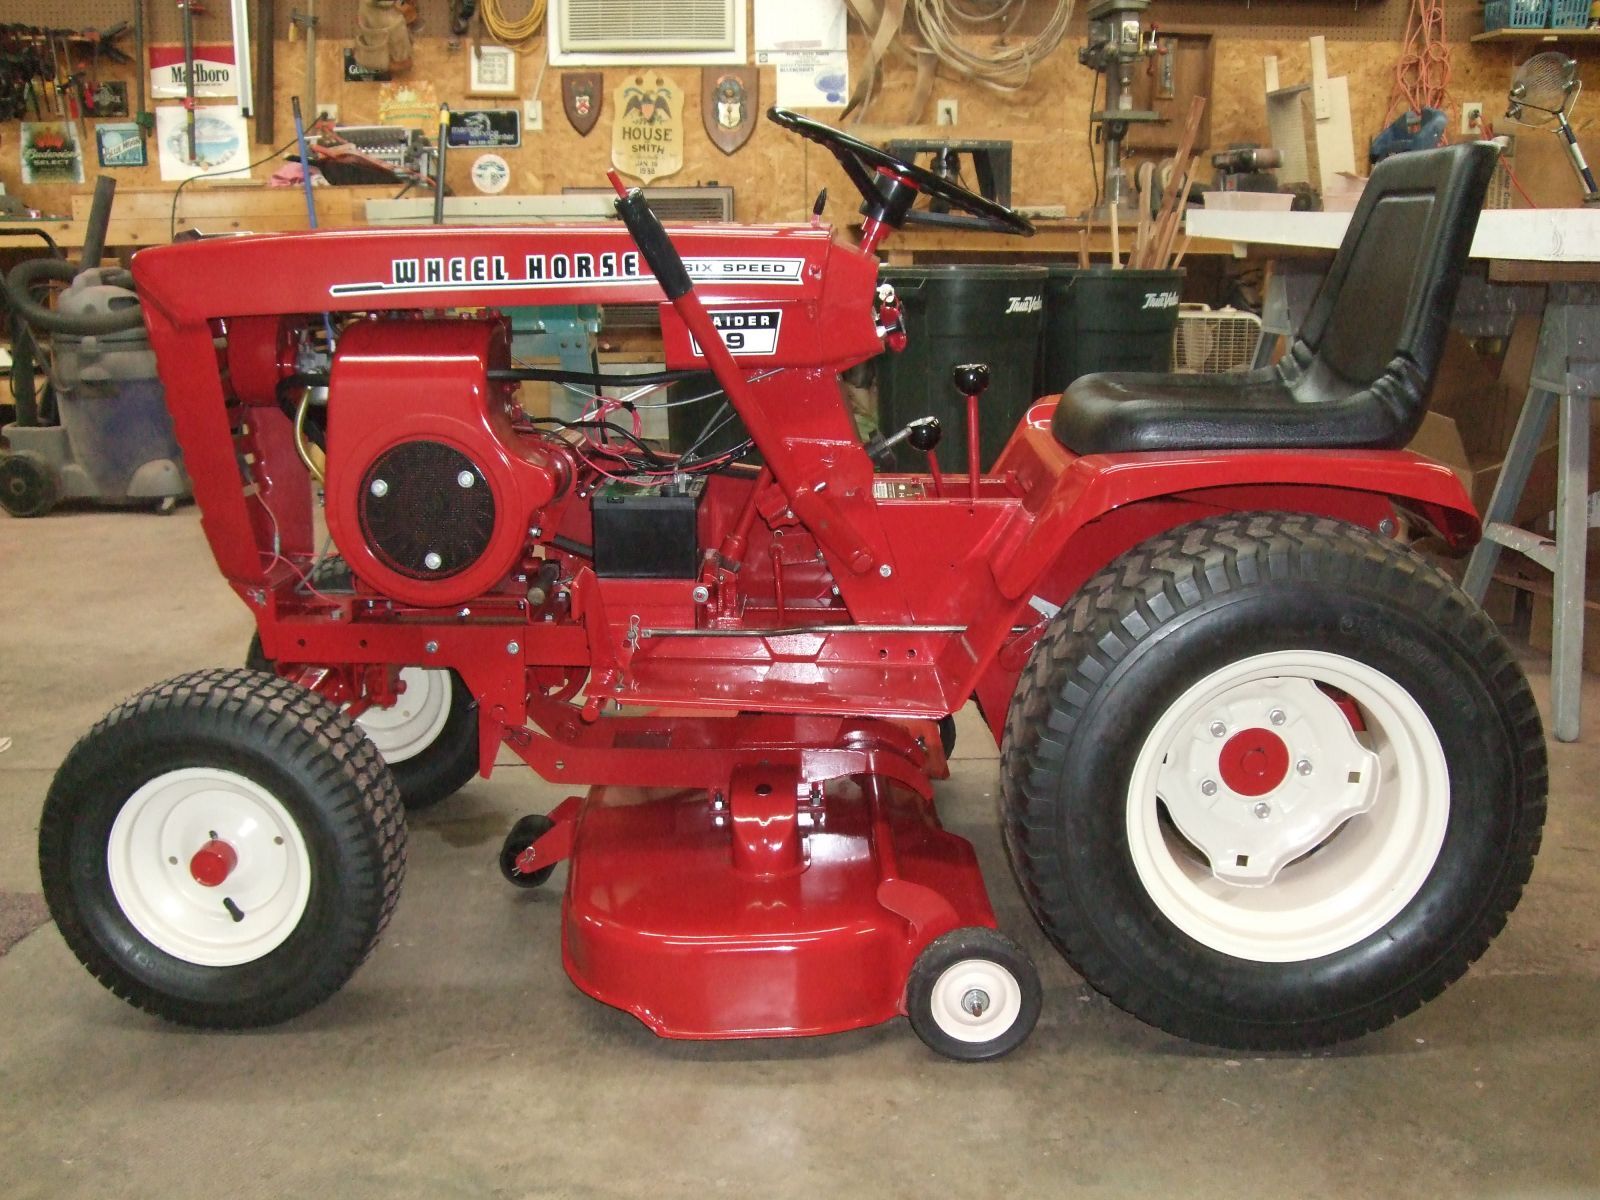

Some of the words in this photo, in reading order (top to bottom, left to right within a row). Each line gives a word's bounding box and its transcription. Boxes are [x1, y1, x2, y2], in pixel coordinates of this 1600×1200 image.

[171, 64, 229, 83] Malboro
[622, 126, 672, 141] HOUSE
[631, 143, 665, 154] SMITH
[393, 256, 508, 285] WHEEL
[526, 252, 639, 280] HORSE
[684, 263, 712, 272] SIX
[723, 263, 786, 273] SPEED
[713, 315, 770, 327] AIDER
[726, 332, 745, 349] 9
